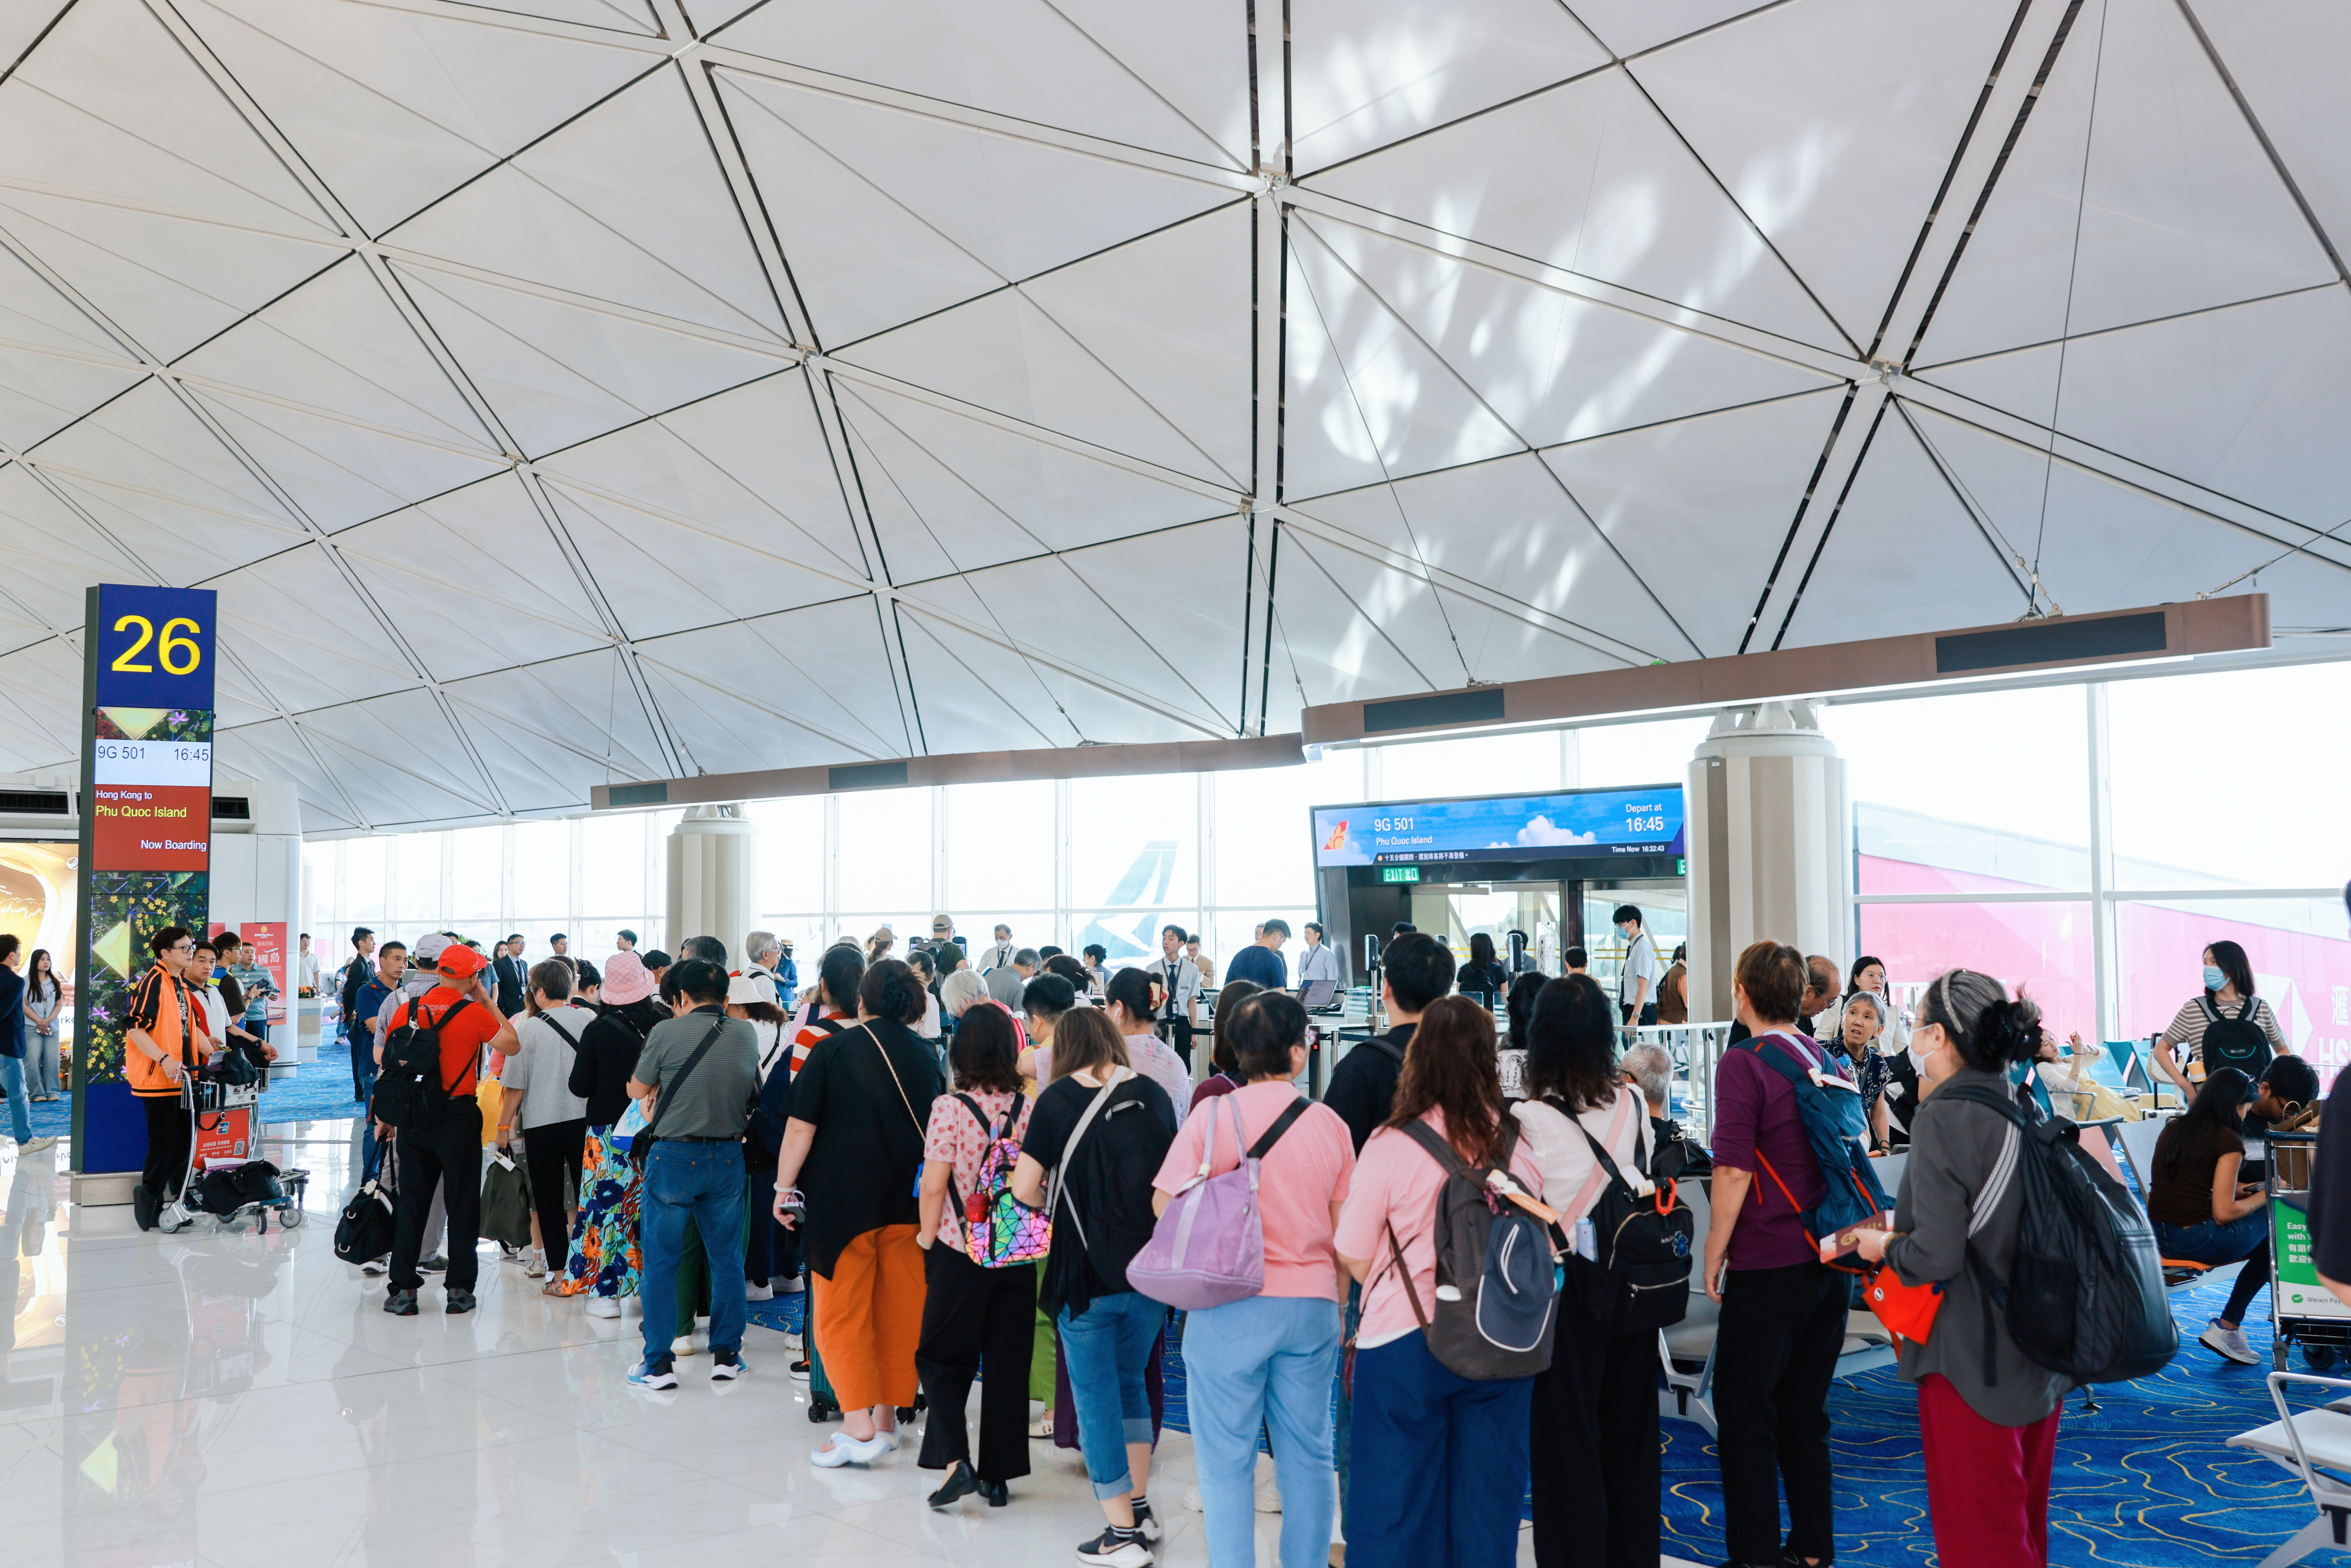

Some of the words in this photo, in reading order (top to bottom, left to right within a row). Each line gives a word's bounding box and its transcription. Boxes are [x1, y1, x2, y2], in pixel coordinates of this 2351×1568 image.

[111, 615, 201, 675] 26
[98, 746, 118, 759] 9G
[122, 746, 145, 759] 501
[174, 748, 209, 761] 16:45
[96, 790, 119, 800] Hong
[120, 790, 142, 801] Kong
[144, 792, 153, 800] to
[96, 805, 118, 816] Phu
[121, 806, 151, 817] Quoc
[155, 806, 187, 817] Island
[1626, 804, 1653, 814] Depart
[1375, 818, 1391, 832] 9G
[1394, 817, 1414, 831] 501
[1626, 816, 1664, 832] 16:45
[140, 839, 163, 849] Now
[165, 840, 207, 852] Boarding
[1377, 837, 1389, 846] Phu
[1391, 837, 1410, 845] Quoc
[1411, 835, 1432, 845] Island
[1386, 869, 1402, 882] EXIT
[1405, 868, 1418, 881] 出口
[255, 952, 280, 965] 國島
[2331, 984, 2351, 1027] 滙
[2318, 1036, 2351, 1079] HS
[2286, 1222, 2307, 1232] Easy
